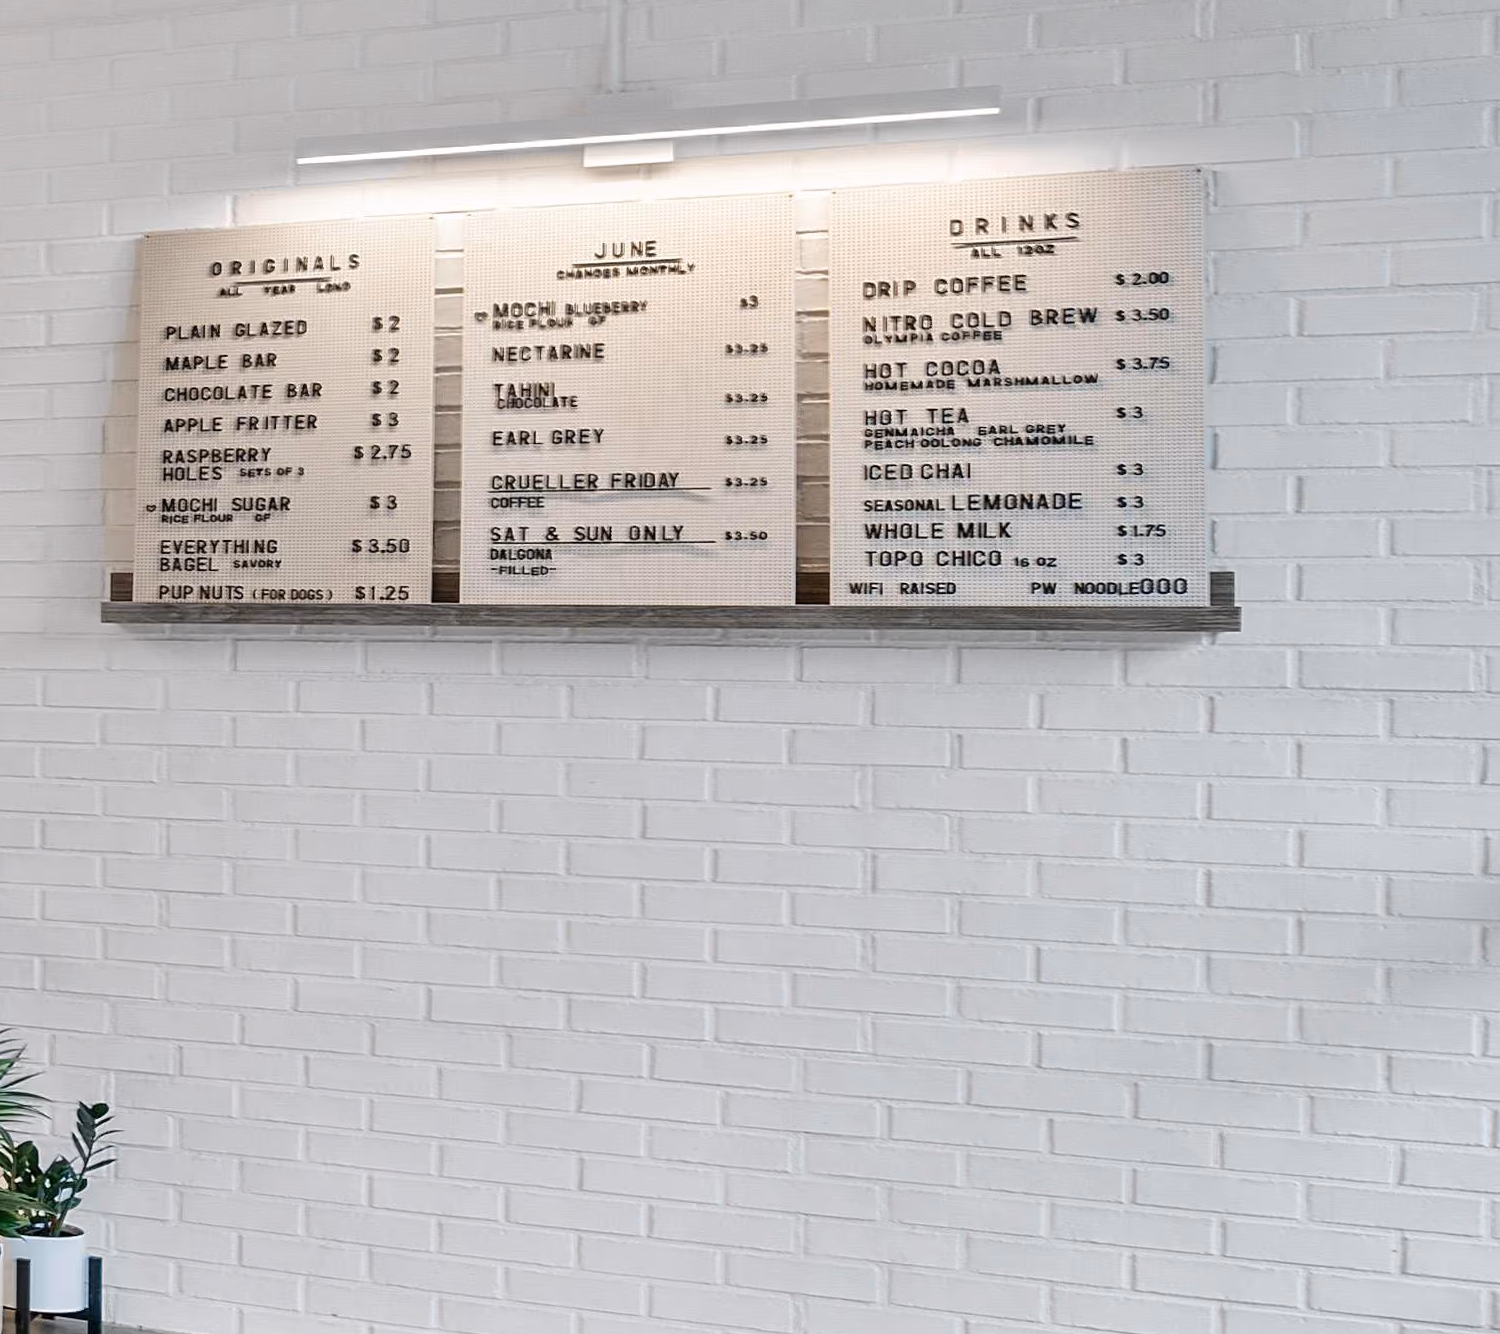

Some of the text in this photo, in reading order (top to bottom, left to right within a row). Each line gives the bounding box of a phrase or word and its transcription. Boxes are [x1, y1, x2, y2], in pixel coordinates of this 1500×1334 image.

[950, 212, 1080, 237] DRINKS
[594, 240, 657, 259] JUNE
[971, 247, 1002, 259] ALL
[212, 254, 360, 276] ORIGINALS
[556, 263, 695, 280] CHANGES MONTHLY
[219, 287, 243, 297] ALL
[264, 284, 296, 296] YEAR
[862, 279, 917, 299] DRIP
[934, 274, 1027, 295] COFFEE
[492, 301, 555, 318] MOCHI
[565, 300, 648, 316] BLUEBERRY
[492, 319, 524, 330] RICE
[529, 317, 573, 329] FLOUR
[862, 314, 933, 332] NITRO
[951, 310, 1012, 329] COLD
[1030, 307, 1098, 327] BREW
[166, 324, 220, 340] PLAIN
[235, 320, 308, 337] GLAZED
[863, 330, 1003, 345] OLYMPIA COFFEE
[492, 343, 768, 362] NECTARINE $3.25
[165, 355, 228, 371] MAPLE
[242, 353, 277, 369] BAR
[864, 362, 907, 379] HOT
[926, 359, 1001, 377] COCOA
[494, 382, 555, 397] TAHINI
[864, 373, 1099, 391] HOMEMADE MARSHMALLOW
[164, 385, 273, 402] CHOCOLATE
[287, 383, 322, 398] BAR
[497, 393, 768, 409] CHOCOLATE $3.25
[164, 417, 223, 433] APPLE
[237, 415, 318, 431] FRITTER
[864, 410, 908, 426] HOT
[927, 408, 969, 424] TEA
[492, 429, 768, 446] EARL GREY $3.25
[864, 424, 1066, 438] GENMAICHA EARL GREY
[864, 435, 1095, 450] PEACH OOLONG CHAMOMILE
[163, 448, 271, 464] RASPBERRY
[163, 466, 305, 481] HOLES SETS OF 3
[864, 464, 913, 481] ICED
[920, 463, 972, 479] CHAI
[491, 473, 768, 490] CRUELLER FRIDAY $3.25
[161, 498, 218, 513] MOCHI
[232, 497, 290, 512] SUGAR
[491, 497, 545, 509] COFFEE
[863, 498, 945, 512] SEASONAL
[952, 493, 1083, 511] LEMONADE
[161, 515, 189, 524] RICE
[194, 514, 233, 523] FLOUR
[491, 525, 768, 542] SAT & SUN ONLY $3.50
[864, 523, 944, 540] WHOLE
[957, 522, 1012, 539] MILK
[160, 539, 278, 555] EVERYTHING
[490, 548, 552, 561] DALGONA
[160, 557, 282, 572] BAGEL SAVORY
[864, 551, 924, 567] TOPO
[935, 550, 1002, 567] CHICO
[1013, 557, 1029, 567] 16
[1036, 557, 1058, 567] OZ
[159, 585, 193, 600] PUP
[200, 586, 244, 600] NUTS
[849, 582, 884, 595] WIFI
[900, 582, 957, 595] RAISED
[1031, 582, 1057, 595] PW
